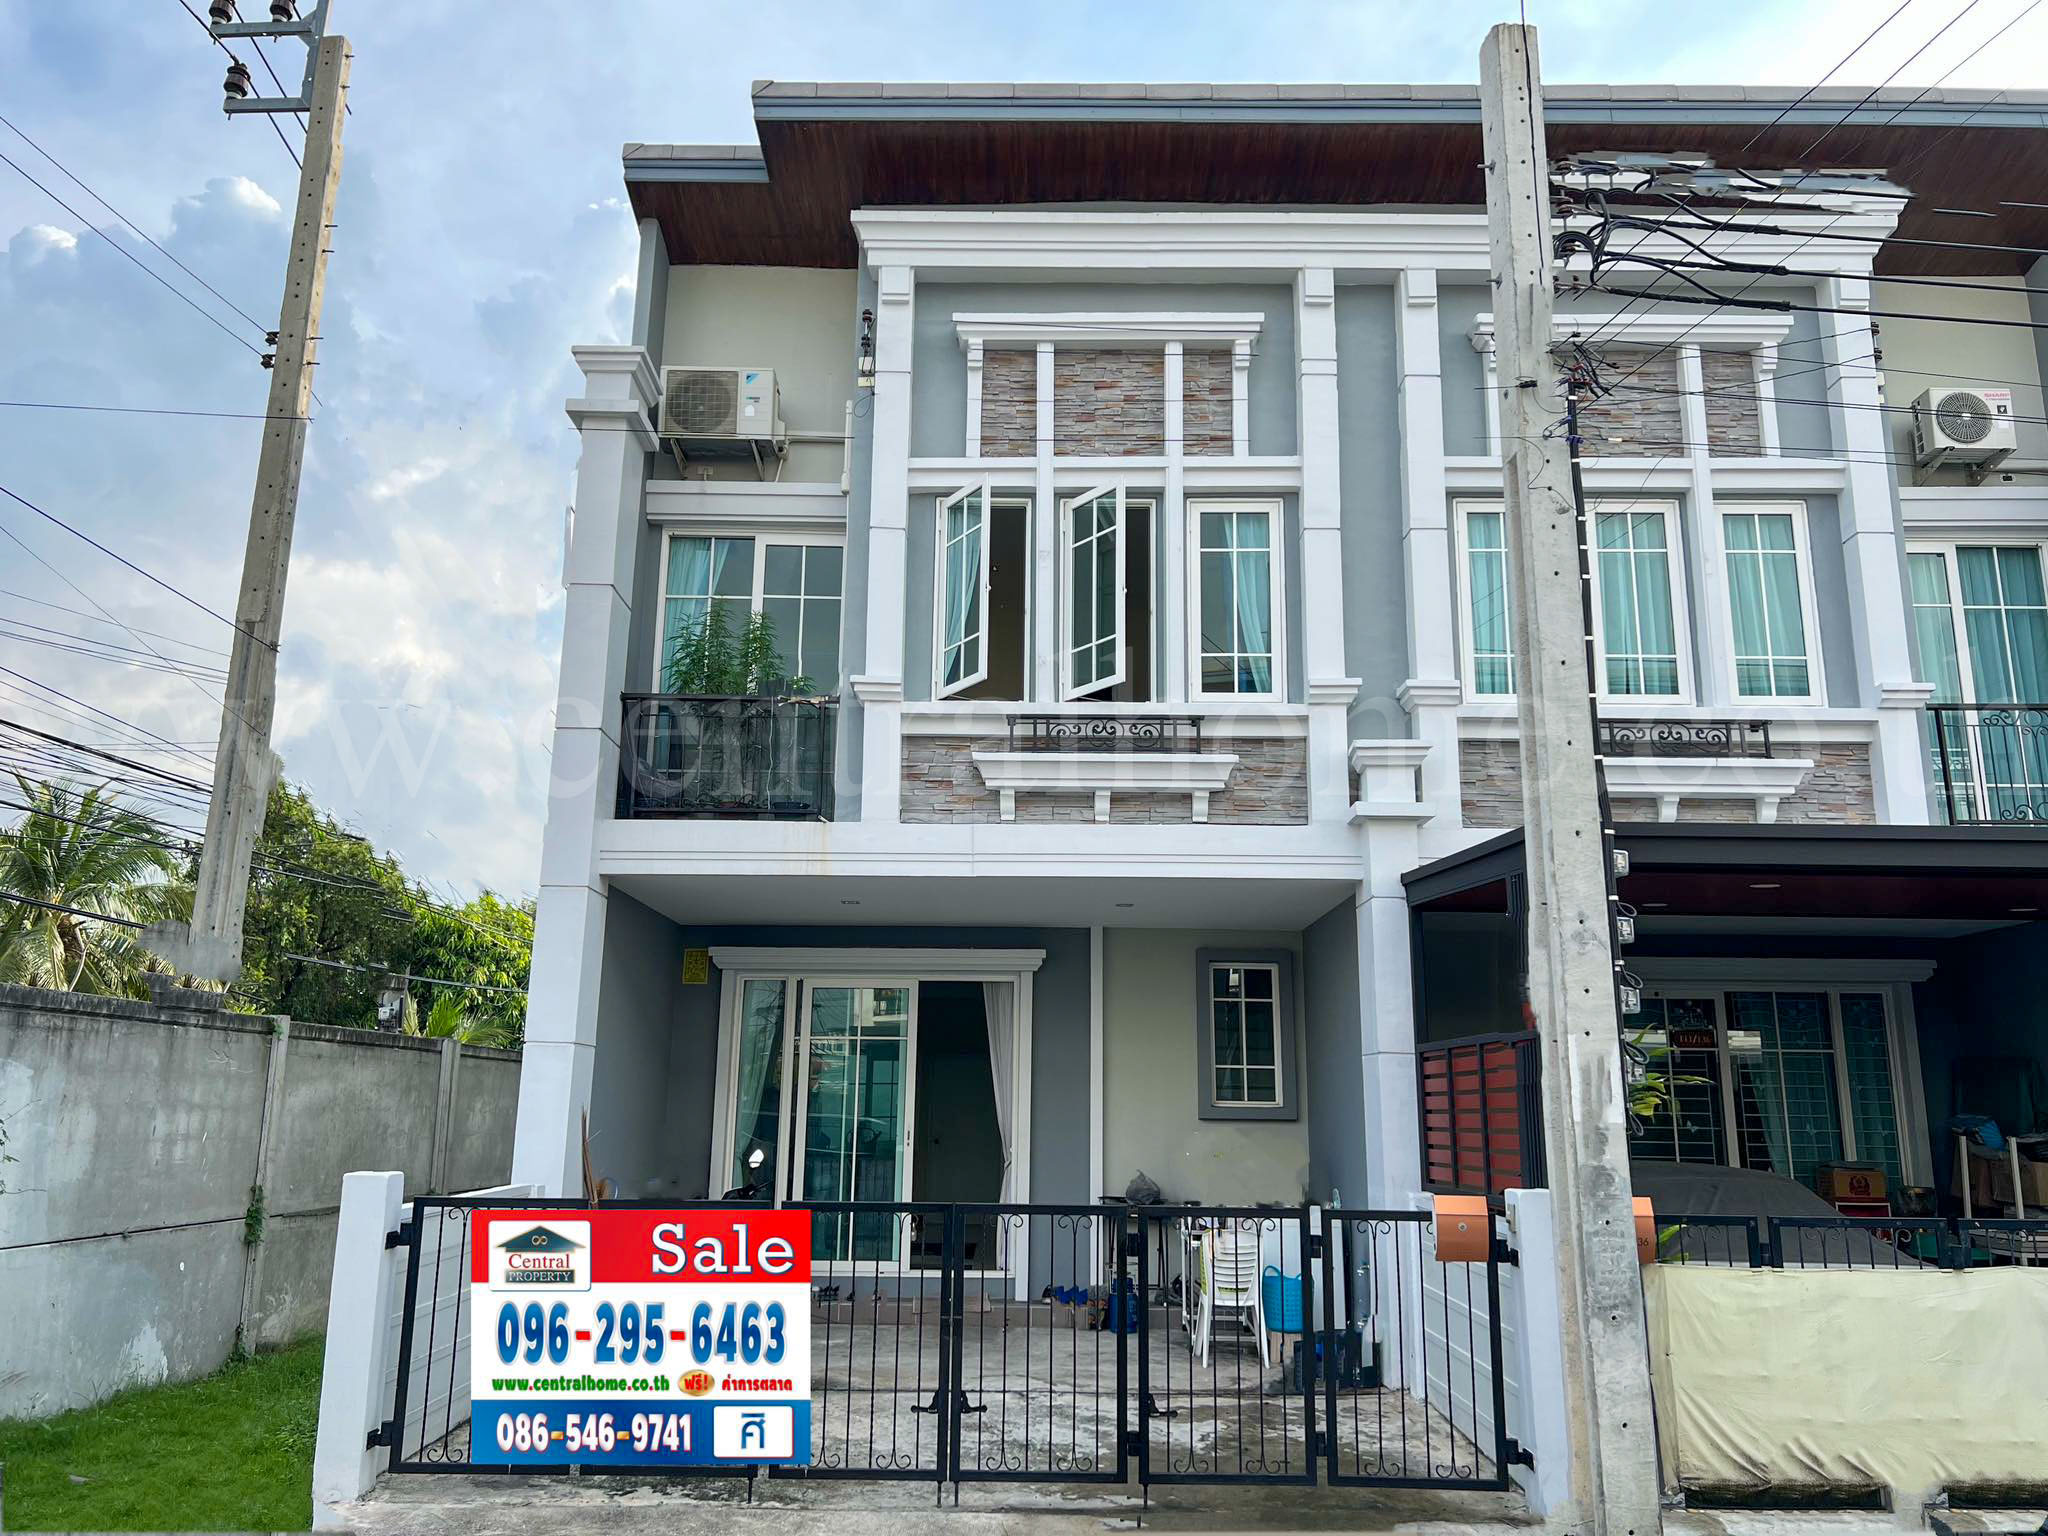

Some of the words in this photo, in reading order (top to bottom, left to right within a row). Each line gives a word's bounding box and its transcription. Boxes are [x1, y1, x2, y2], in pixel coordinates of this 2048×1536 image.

[652, 1223, 795, 1275] Sale
[508, 1253, 570, 1269] Central
[509, 1271, 571, 1282] PROPERTY
[495, 1300, 787, 1366] 096-295-6463
[492, 1374, 670, 1392] www.centralhome.co.th
[684, 1373, 709, 1391] ฟรี!
[721, 1374, 793, 1391] ค่าการตลาด
[496, 1412, 692, 1452] 086-546-9741
